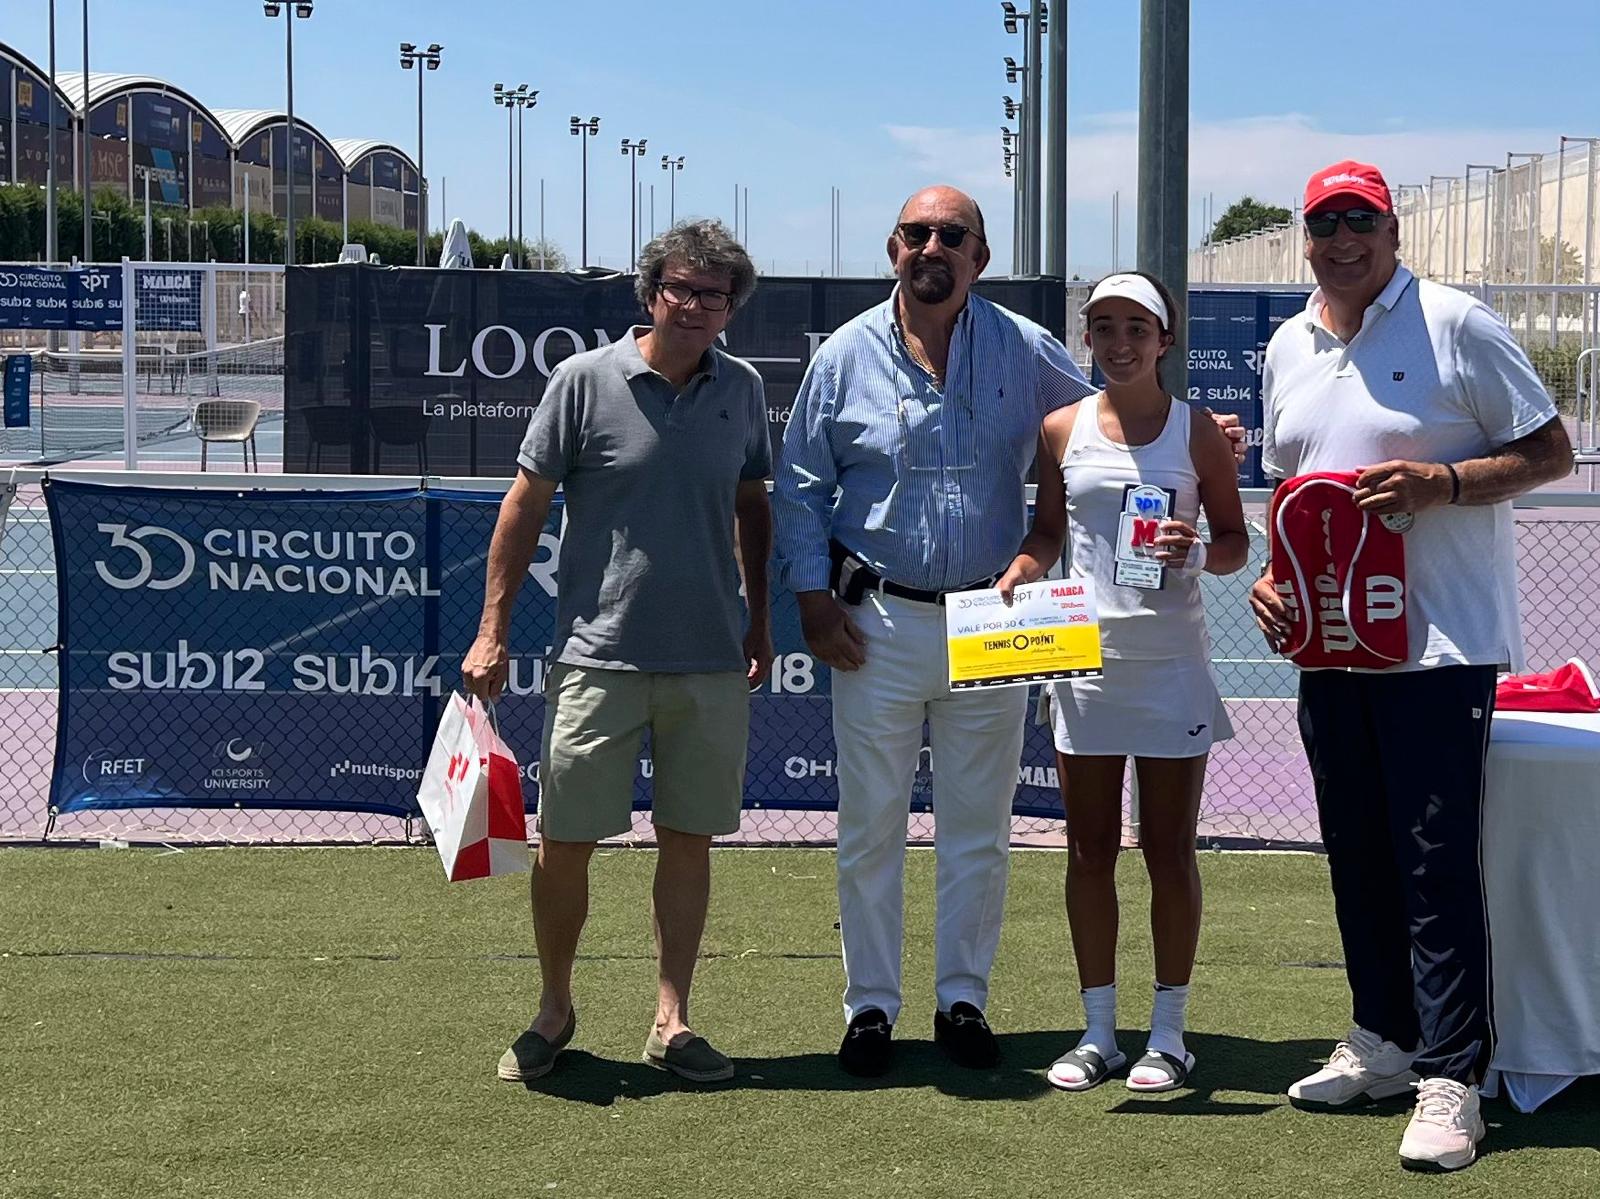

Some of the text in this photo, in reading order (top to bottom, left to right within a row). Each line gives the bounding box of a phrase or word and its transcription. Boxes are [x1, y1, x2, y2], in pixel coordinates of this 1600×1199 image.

[25, 149, 66, 165] VOLO
[19, 273, 62, 282] CIRCUITO
[19, 280, 67, 289] NACIONAL
[79, 274, 110, 292] RPT
[142, 275, 191, 289] MARCA
[0, 296, 31, 307] sub12
[36, 297, 67, 308] sub14
[72, 298, 104, 309] sub16
[1188, 349, 1228, 360] CUITO
[1187, 360, 1235, 370] CIONAL
[1207, 384, 1252, 400] sub14
[423, 400, 538, 420] La plataform
[203, 528, 416, 561] CIRCUITO
[95, 522, 196, 590] 30
[208, 562, 441, 597] NACIONAL
[1051, 586, 1084, 597] MARCA
[957, 623, 981, 634] VALE
[983, 622, 1002, 631] POR
[1004, 619, 1017, 629] 50
[983, 632, 1055, 651] TENNIS POINT
[107, 639, 266, 690] sub12
[292, 645, 442, 697] sub14
[101, 758, 145, 775] RFET
[225, 769, 264, 777] SPORTS
[351, 762, 425, 781] nutrispor
[204, 779, 271, 789] UNIVERSITY
[1017, 766, 1060, 788] MAR
